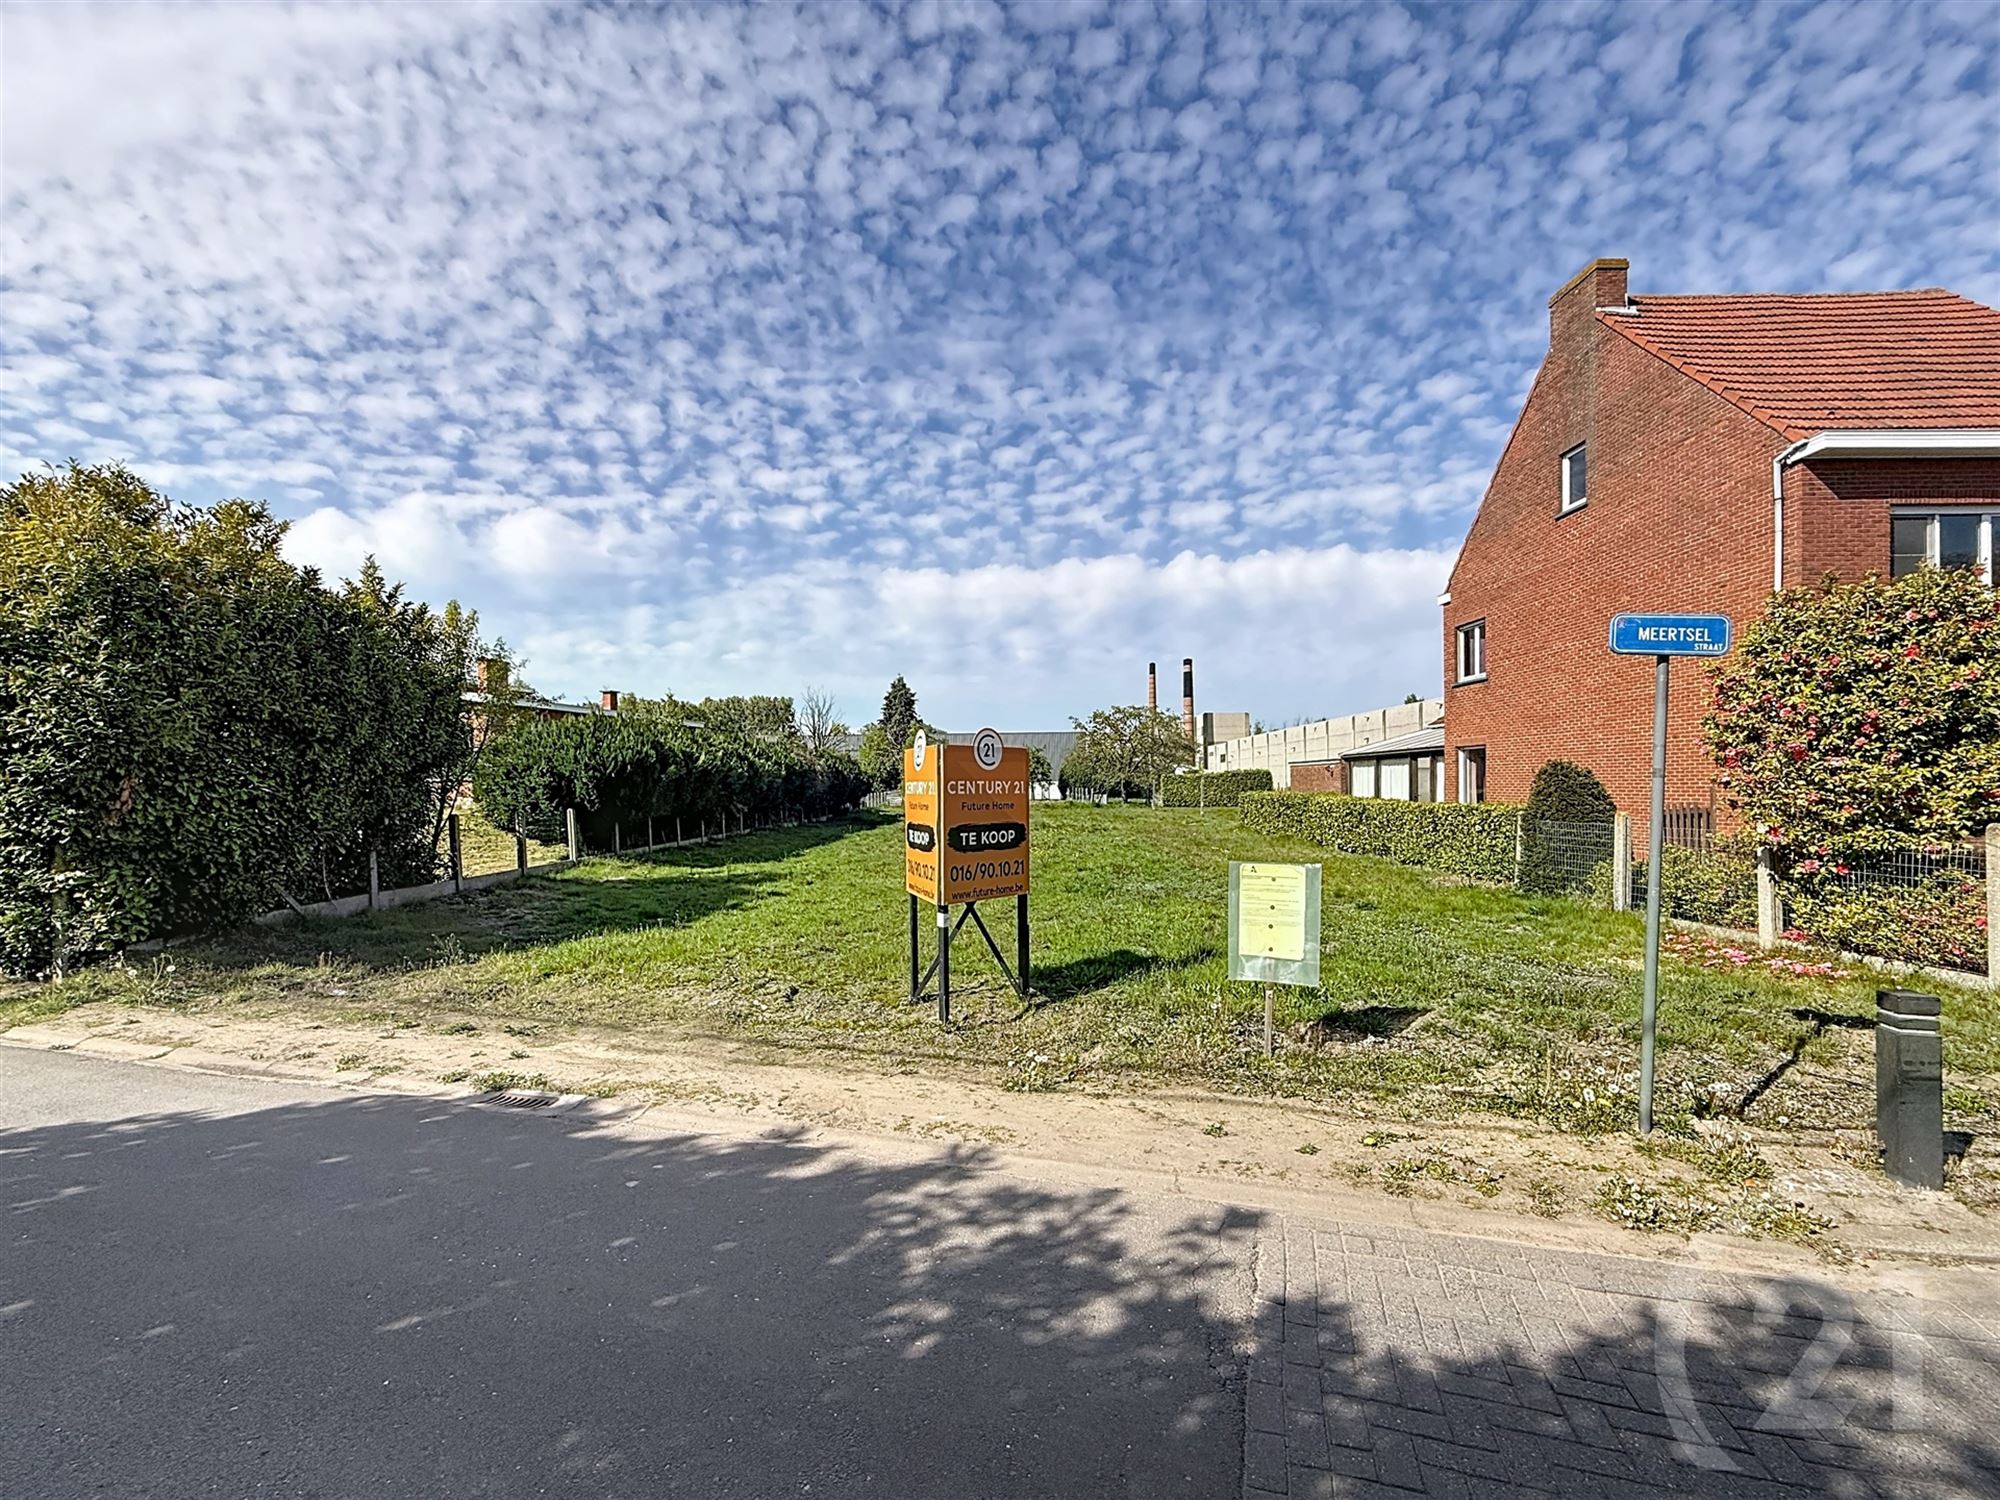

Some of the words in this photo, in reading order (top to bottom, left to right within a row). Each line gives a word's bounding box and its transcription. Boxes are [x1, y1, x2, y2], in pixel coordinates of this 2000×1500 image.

[1638, 627, 1712, 642] MEERTSEL
[1694, 643, 1723, 651] STRAAT
[947, 780, 1011, 795] CENTURY
[961, 802, 990, 811] Future
[992, 801, 1015, 810] Home
[960, 832, 977, 846] TE
[981, 830, 1016, 845] KOOP
[950, 860, 1025, 882] 016/90.10.21
[951, 882, 1024, 900] www.future-home.be
